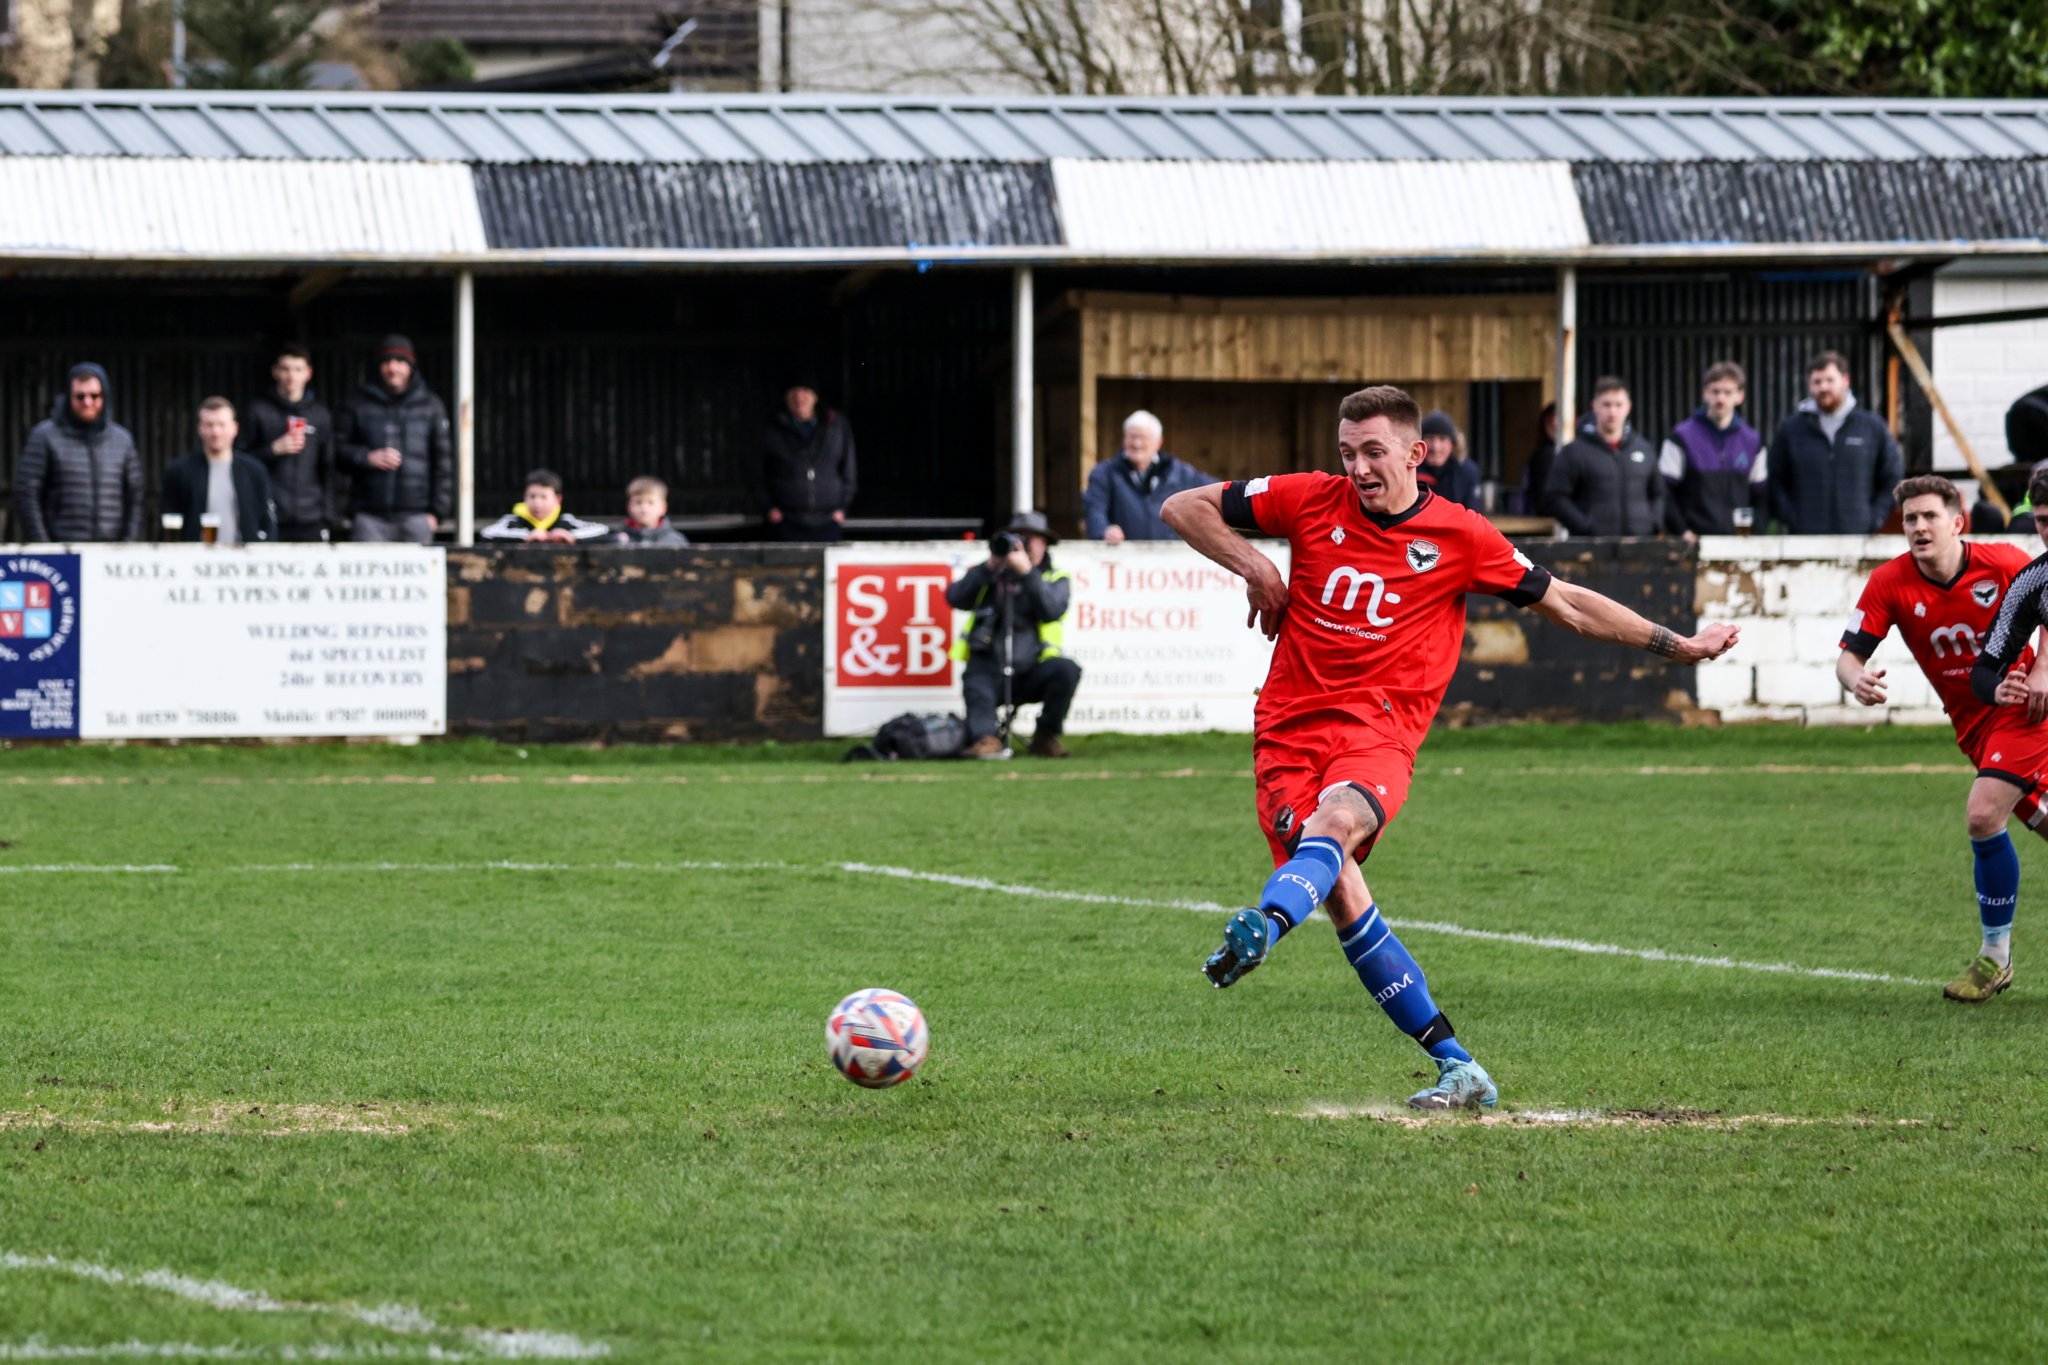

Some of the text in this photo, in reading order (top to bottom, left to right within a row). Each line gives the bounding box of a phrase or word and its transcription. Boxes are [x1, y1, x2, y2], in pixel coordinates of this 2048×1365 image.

[192, 560, 306, 579] SERVICING
[312, 560, 329, 578] &
[339, 560, 428, 578] REPAIRS
[165, 585, 428, 604] ALL TYPES OF VEHICLES
[1077, 601, 1204, 632] BRISCOE
[246, 623, 429, 641] WELDING REPAIRS
[1314, 617, 1387, 643] manx telecom
[320, 646, 427, 664] SPECIALIST
[324, 669, 424, 688] RECOVERY
